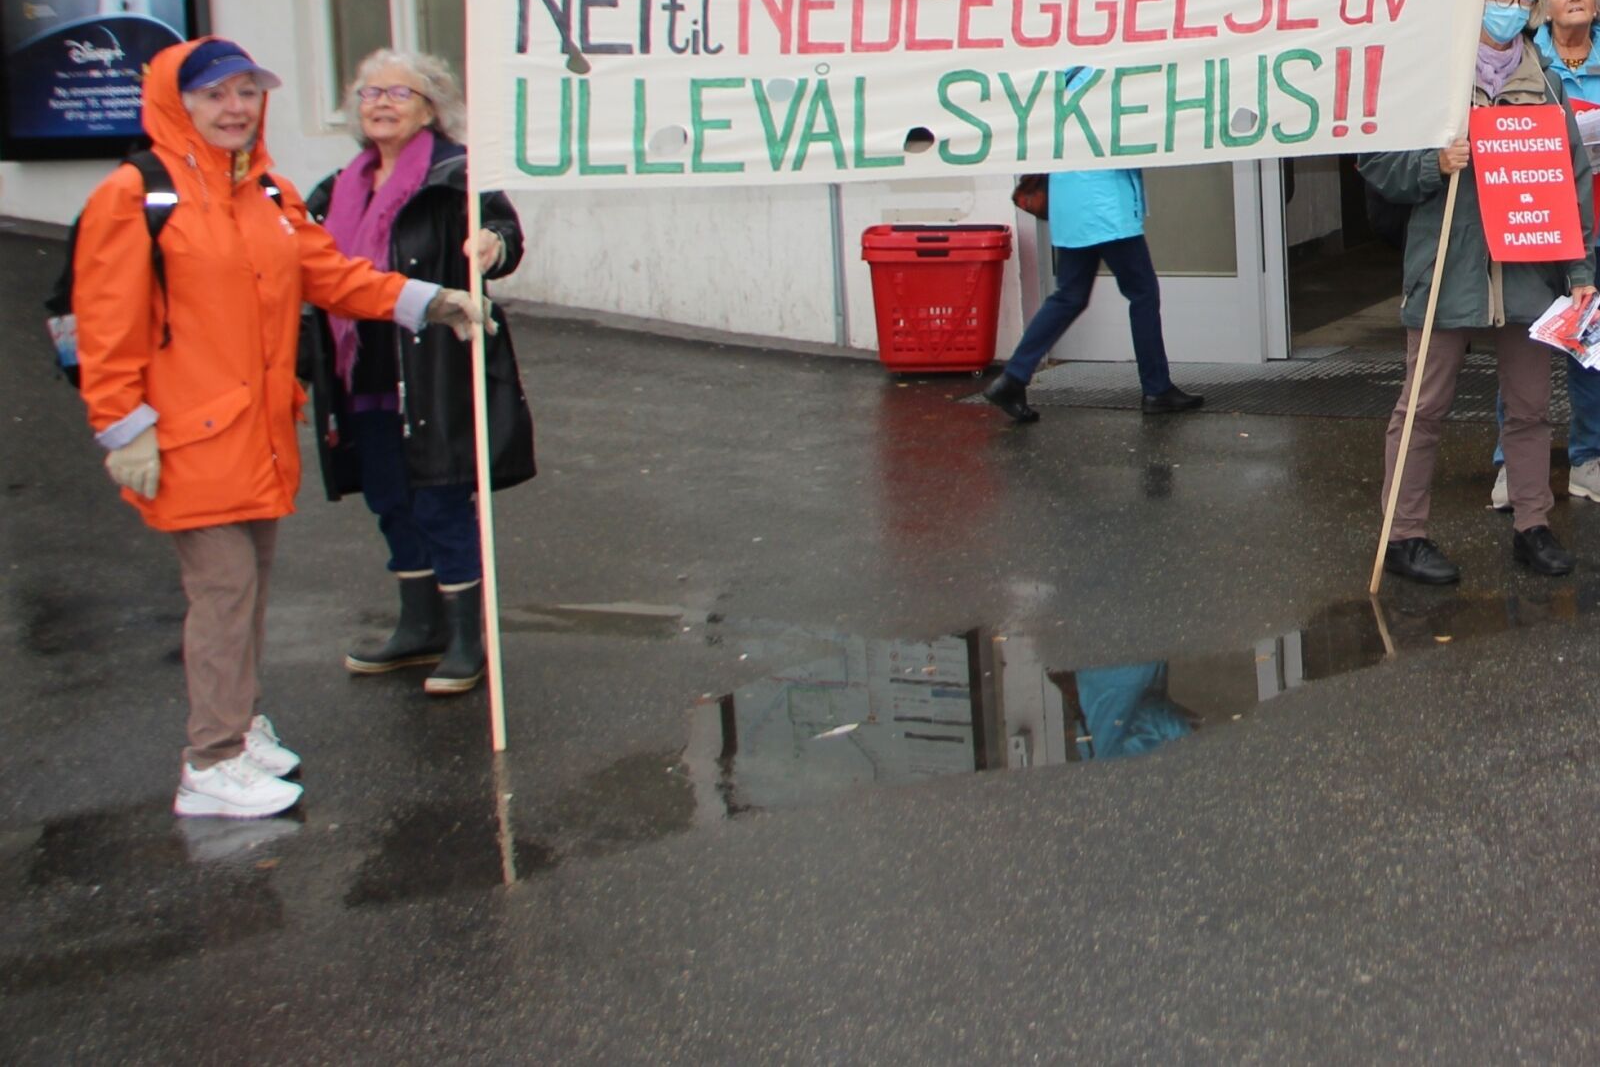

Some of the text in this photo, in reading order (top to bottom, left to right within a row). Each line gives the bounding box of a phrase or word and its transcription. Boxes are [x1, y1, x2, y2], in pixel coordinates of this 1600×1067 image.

[515, 44, 1386, 176] ULLEVÅL SYKEHUS!!
[1496, 117, 1537, 131] OSLO-
[1476, 137, 1563, 153] SYKEHUSENE
[1485, 166, 1564, 184] MÅ REDDES
[1508, 210, 1550, 224] SKROT
[1504, 231, 1562, 245] PLANENE
